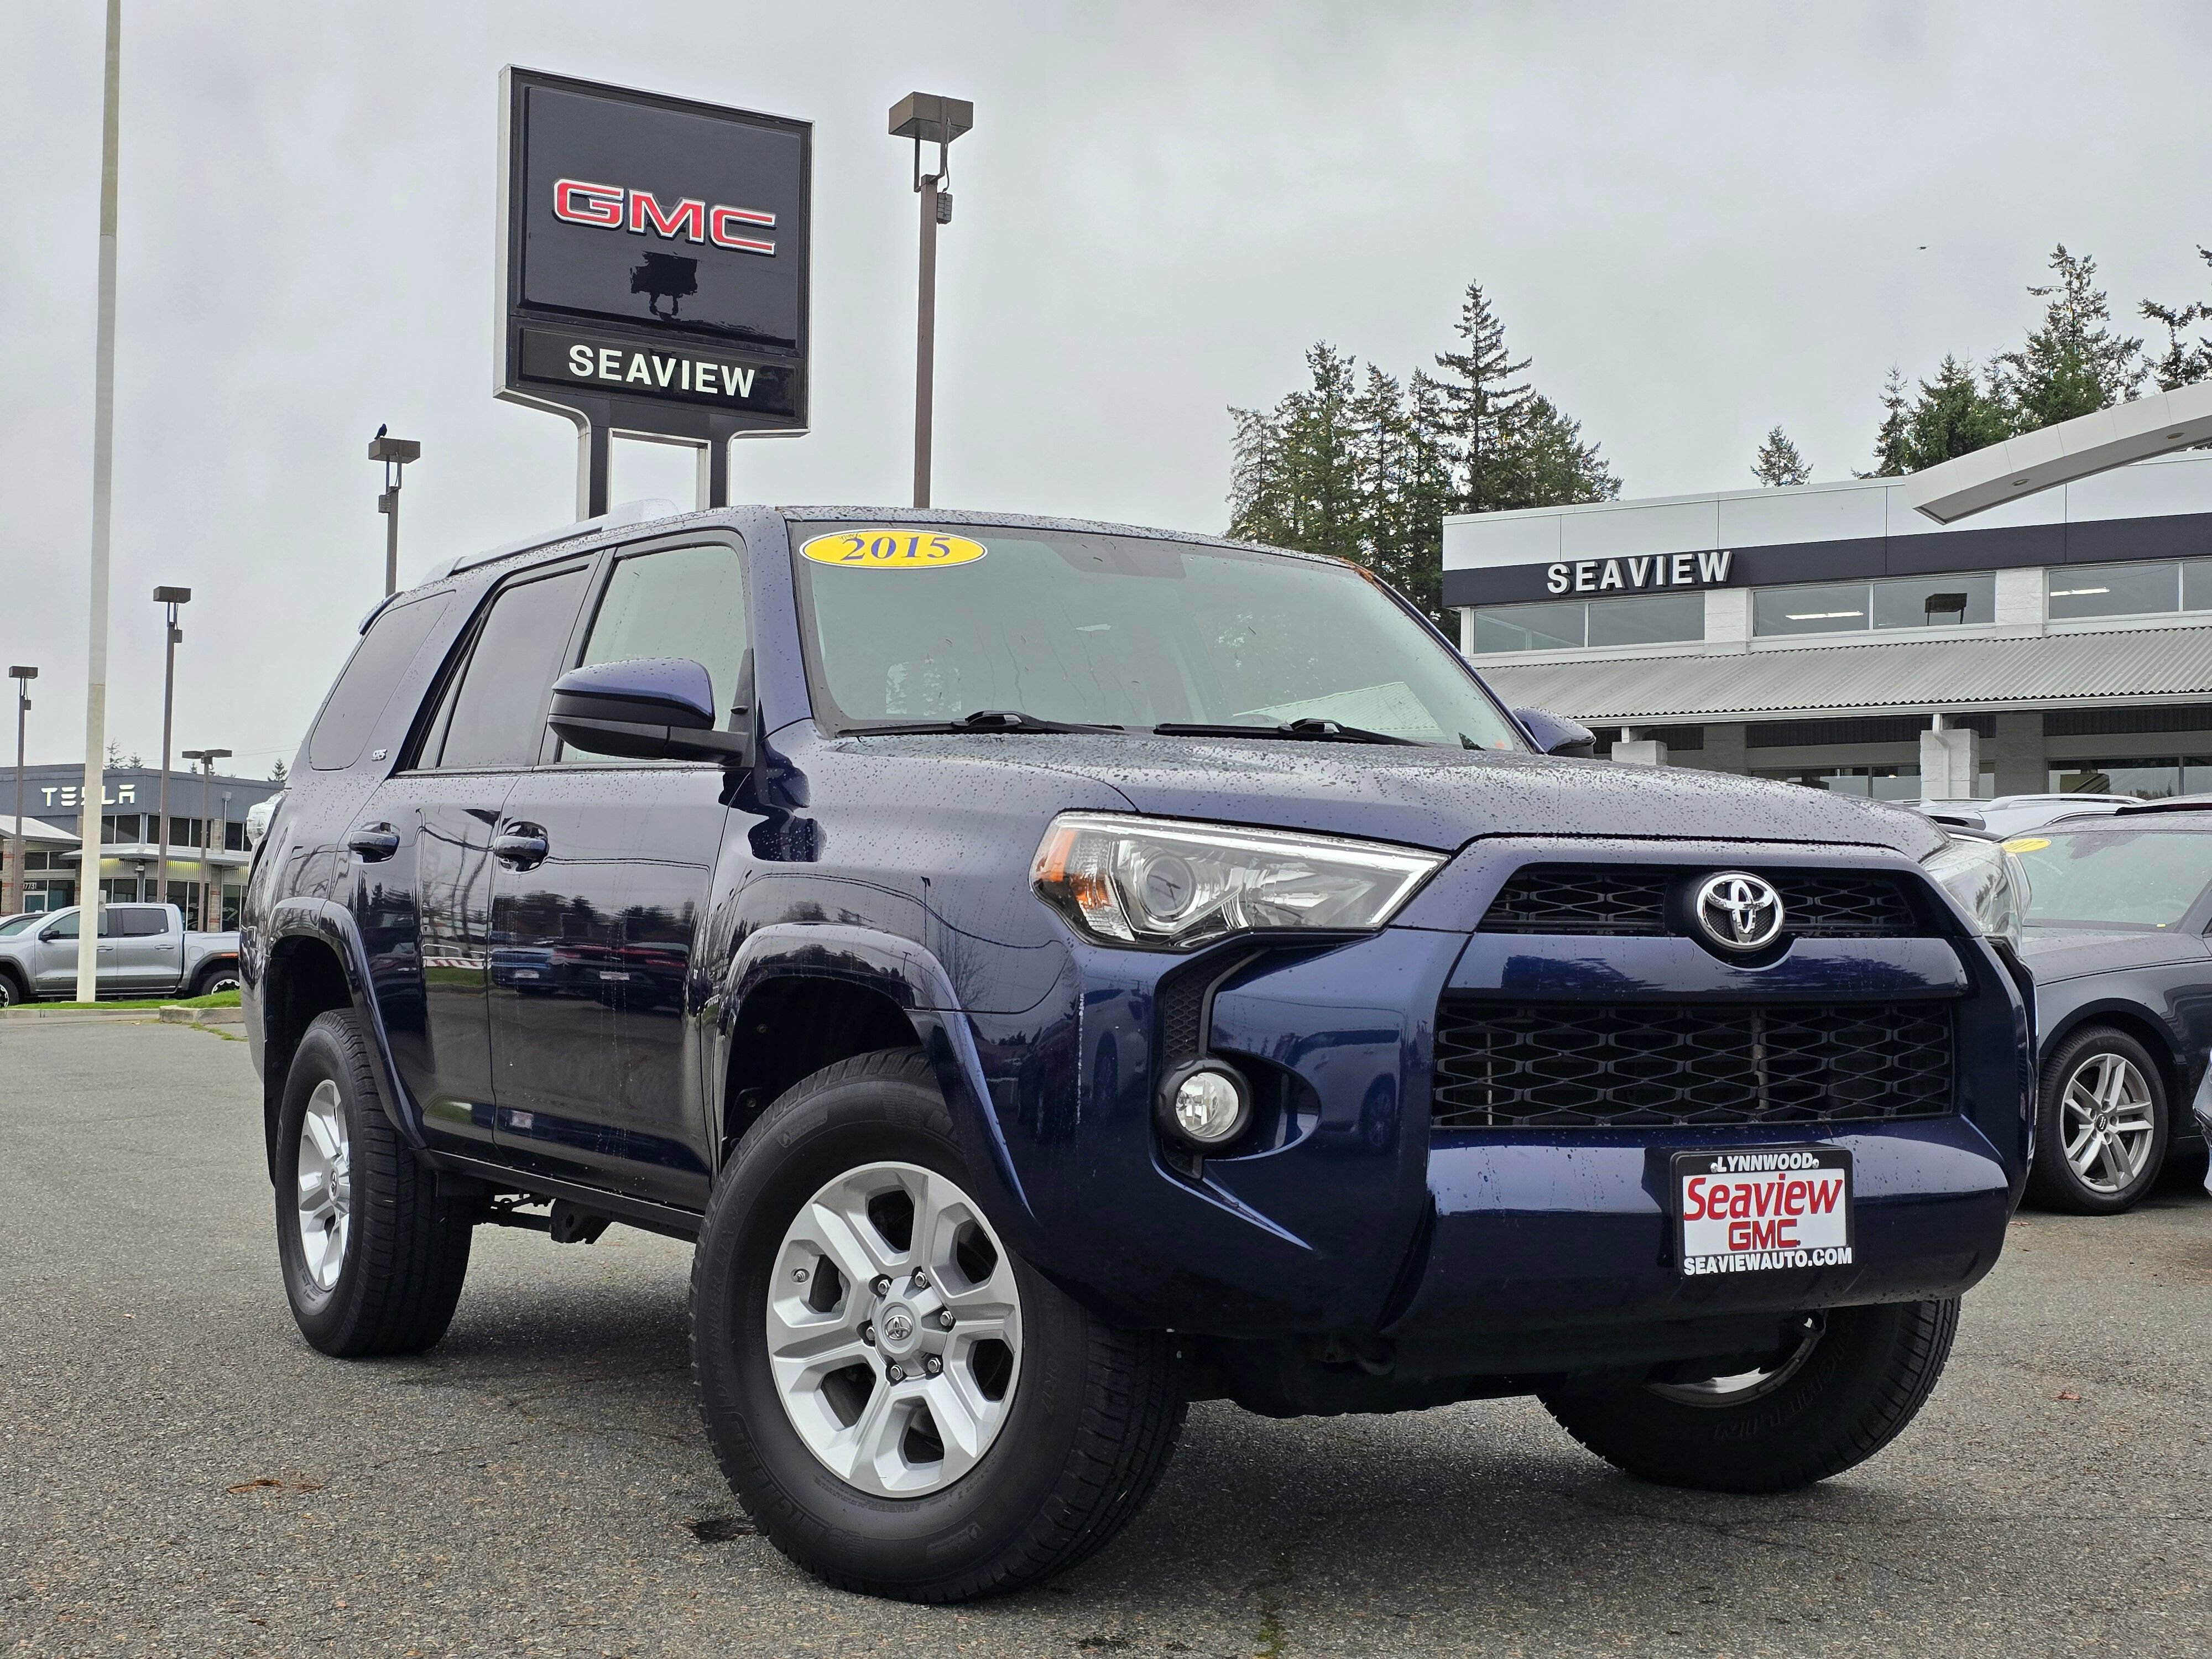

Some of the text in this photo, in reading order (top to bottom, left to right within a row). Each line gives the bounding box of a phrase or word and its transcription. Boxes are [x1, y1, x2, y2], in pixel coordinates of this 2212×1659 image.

[554, 179, 776, 255] GMC
[568, 345, 755, 398] SEAVIEW
[840, 536, 951, 561] 2015
[1547, 551, 1732, 594] SEAVIEW
[41, 784, 135, 807] TELA
[1718, 1153, 1813, 1172] LYNNWOOD
[1683, 1173, 1843, 1221] Seaview
[1729, 1219, 1799, 1251] GMC
[1684, 1248, 1852, 1276] SEAVIEWAUTO.COM
